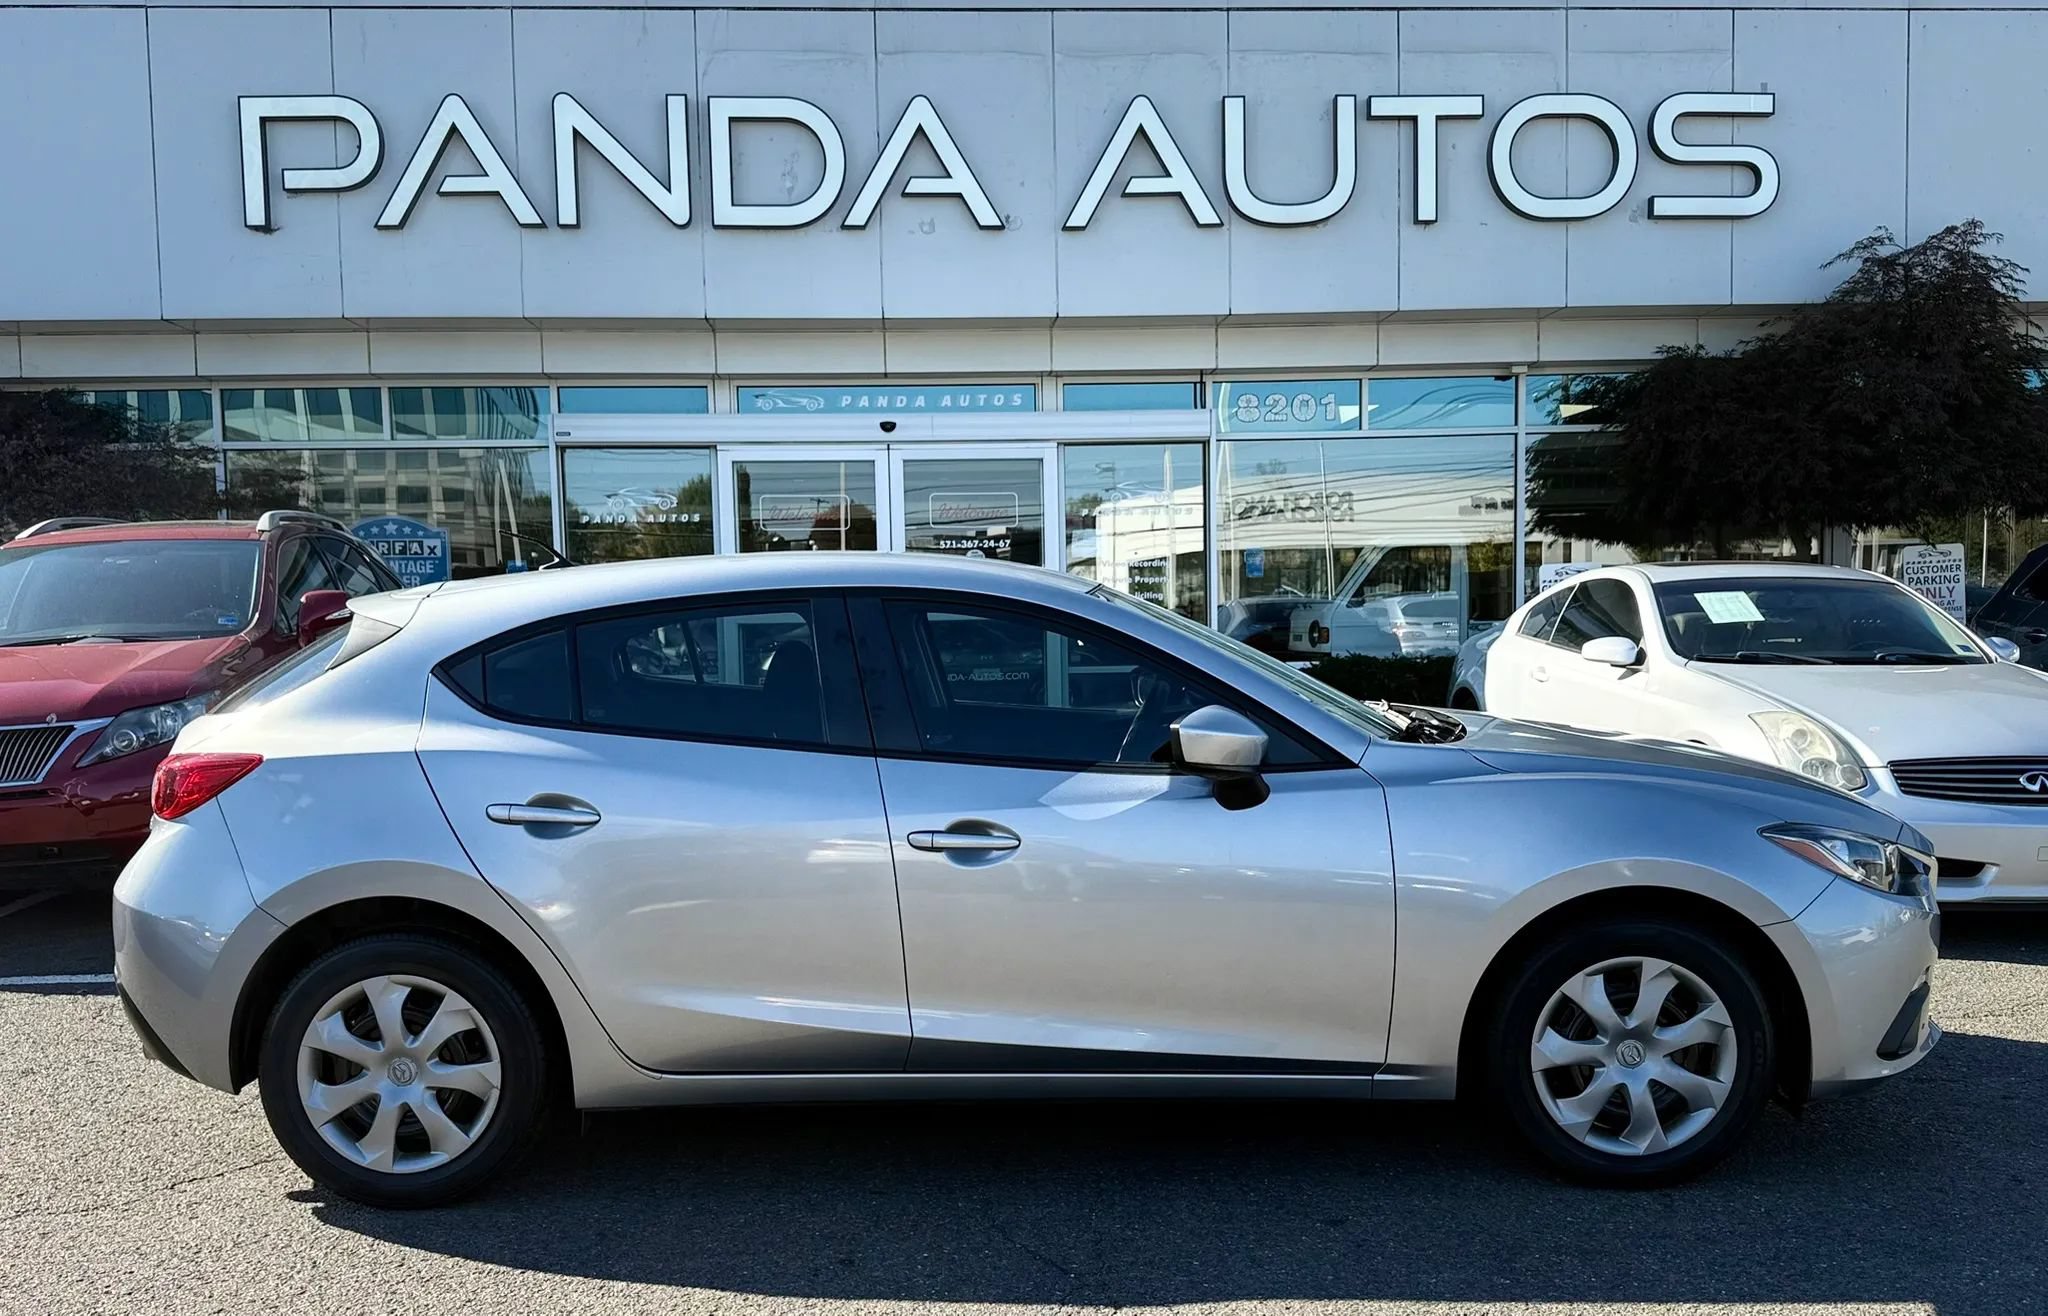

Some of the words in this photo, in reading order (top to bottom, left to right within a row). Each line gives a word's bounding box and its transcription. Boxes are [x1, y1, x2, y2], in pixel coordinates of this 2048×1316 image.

[237, 91, 1006, 230] PANDA
[1062, 92, 1781, 231] AUTOS
[841, 395, 925, 408] PANDA
[941, 393, 1023, 407] AUTOS
[1236, 392, 1338, 423] 8201
[582, 514, 638, 523] PANDA
[647, 513, 701, 522] AUTOS
[769, 504, 839, 521] Welcome
[940, 502, 1010, 520] Welcome
[375, 541, 438, 556] RFAX
[939, 539, 1011, 549] 571-367-24-67
[389, 560, 435, 574] NTAGE
[1905, 564, 1962, 575] CUSTOMER
[1908, 574, 1961, 586] PARKING
